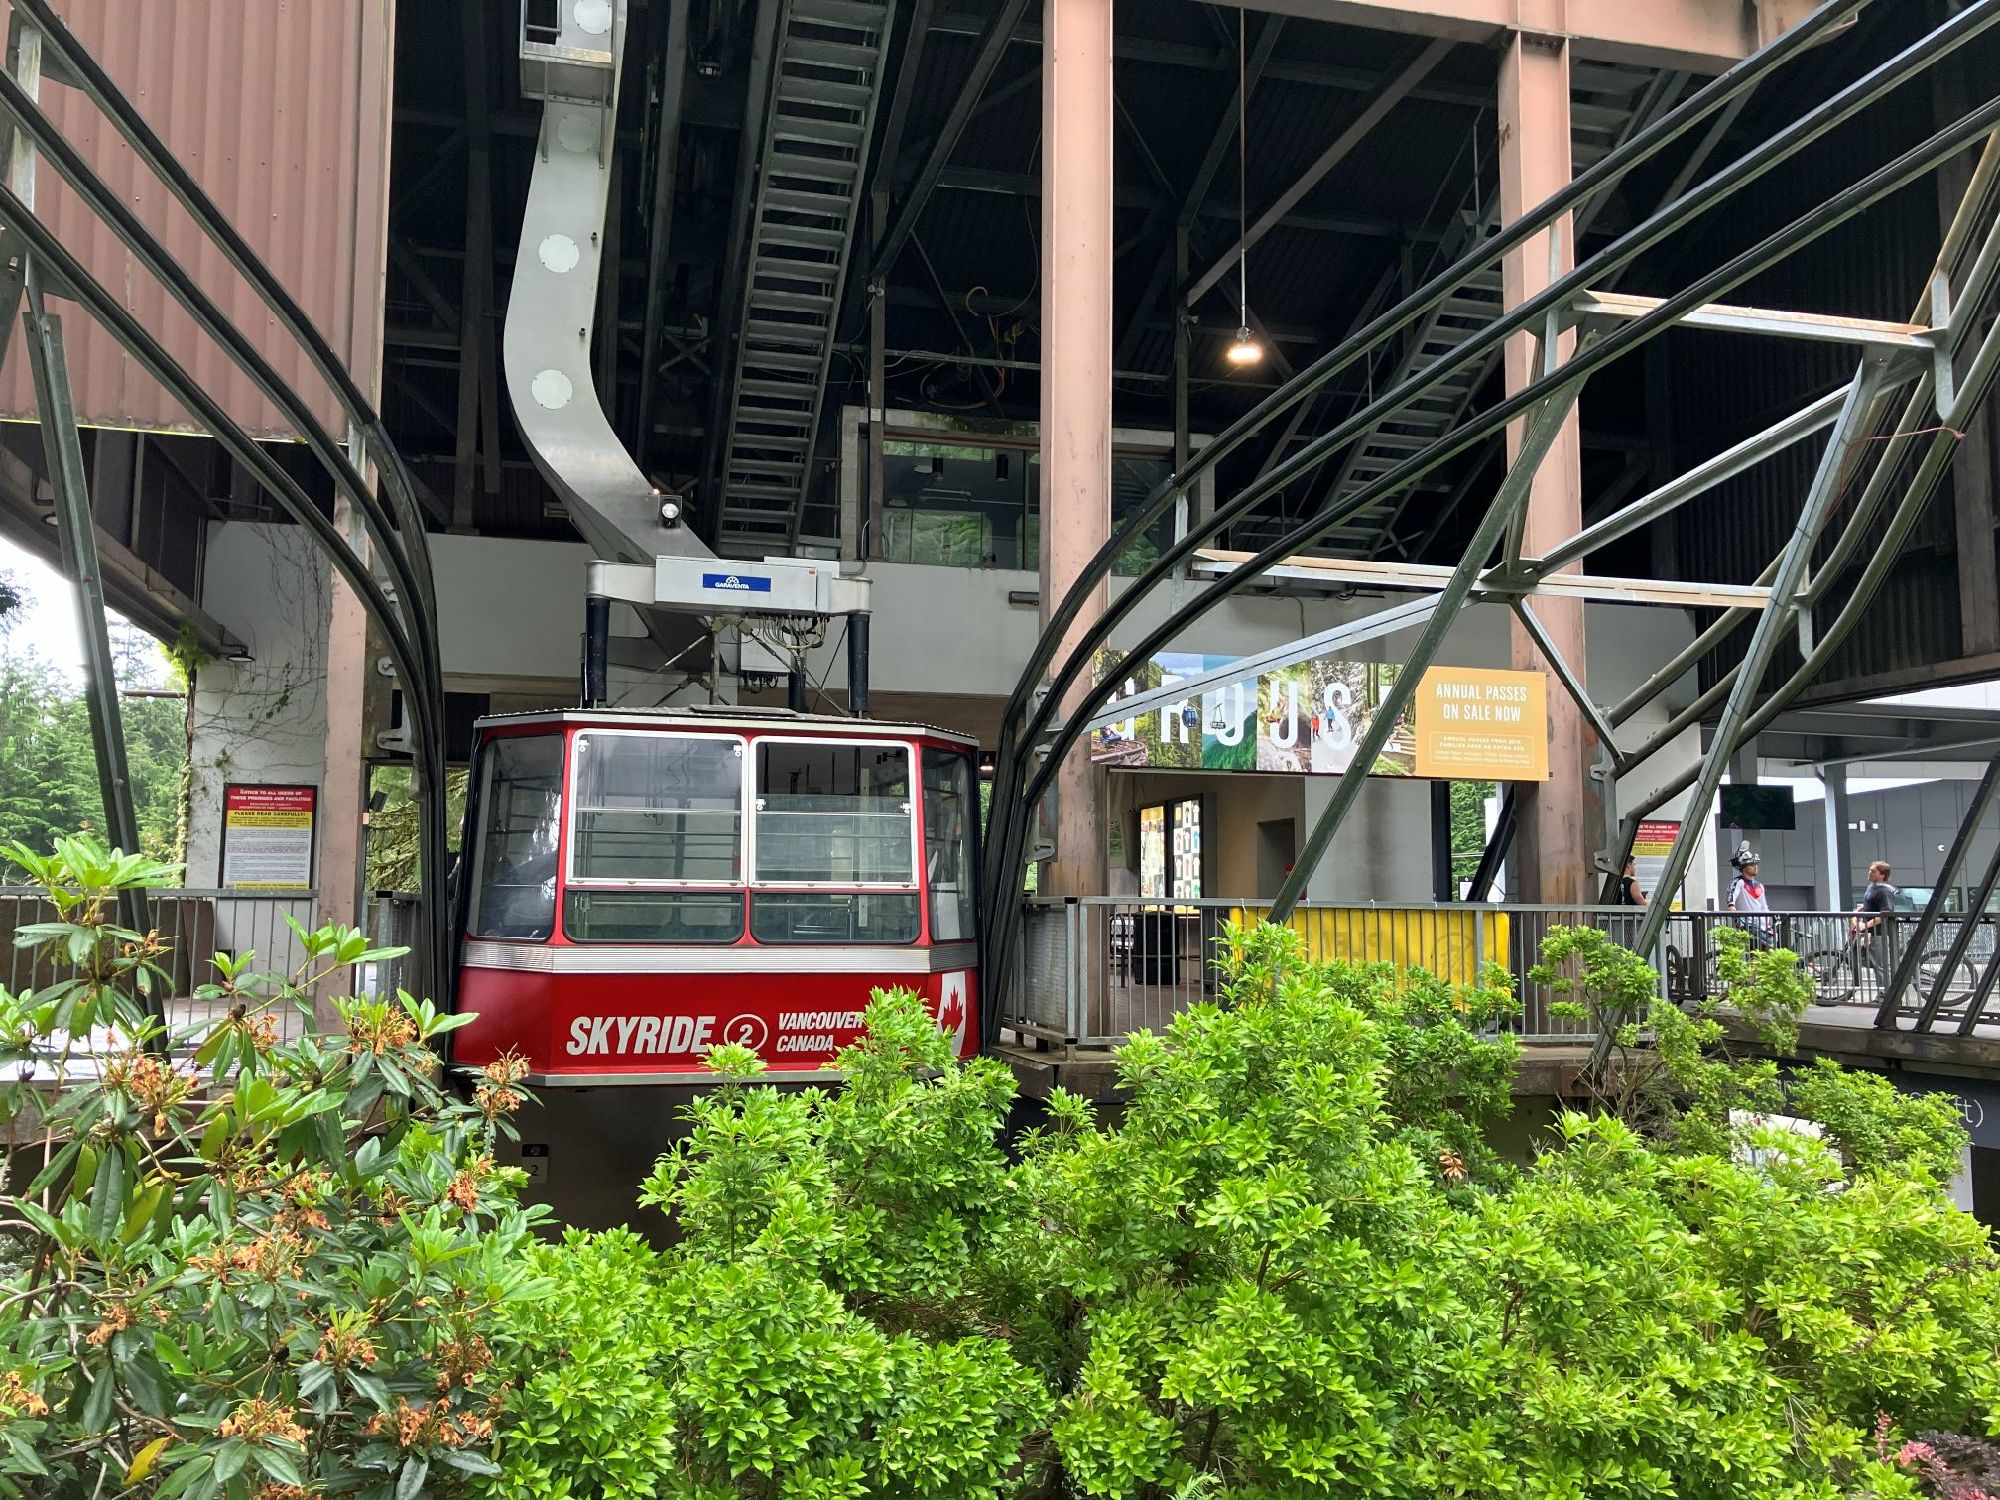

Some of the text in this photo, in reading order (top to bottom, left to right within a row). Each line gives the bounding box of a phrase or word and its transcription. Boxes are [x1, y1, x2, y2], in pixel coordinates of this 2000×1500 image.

[715, 582, 749, 590] GARAVENTA
[1436, 683, 1527, 702] ANNUAL PASSES
[1443, 703, 1521, 722] ON SALE NOW
[566, 1011, 866, 1056] SKYRIDE 2 VANCOUVER
[776, 1034, 834, 1052] CANADA
